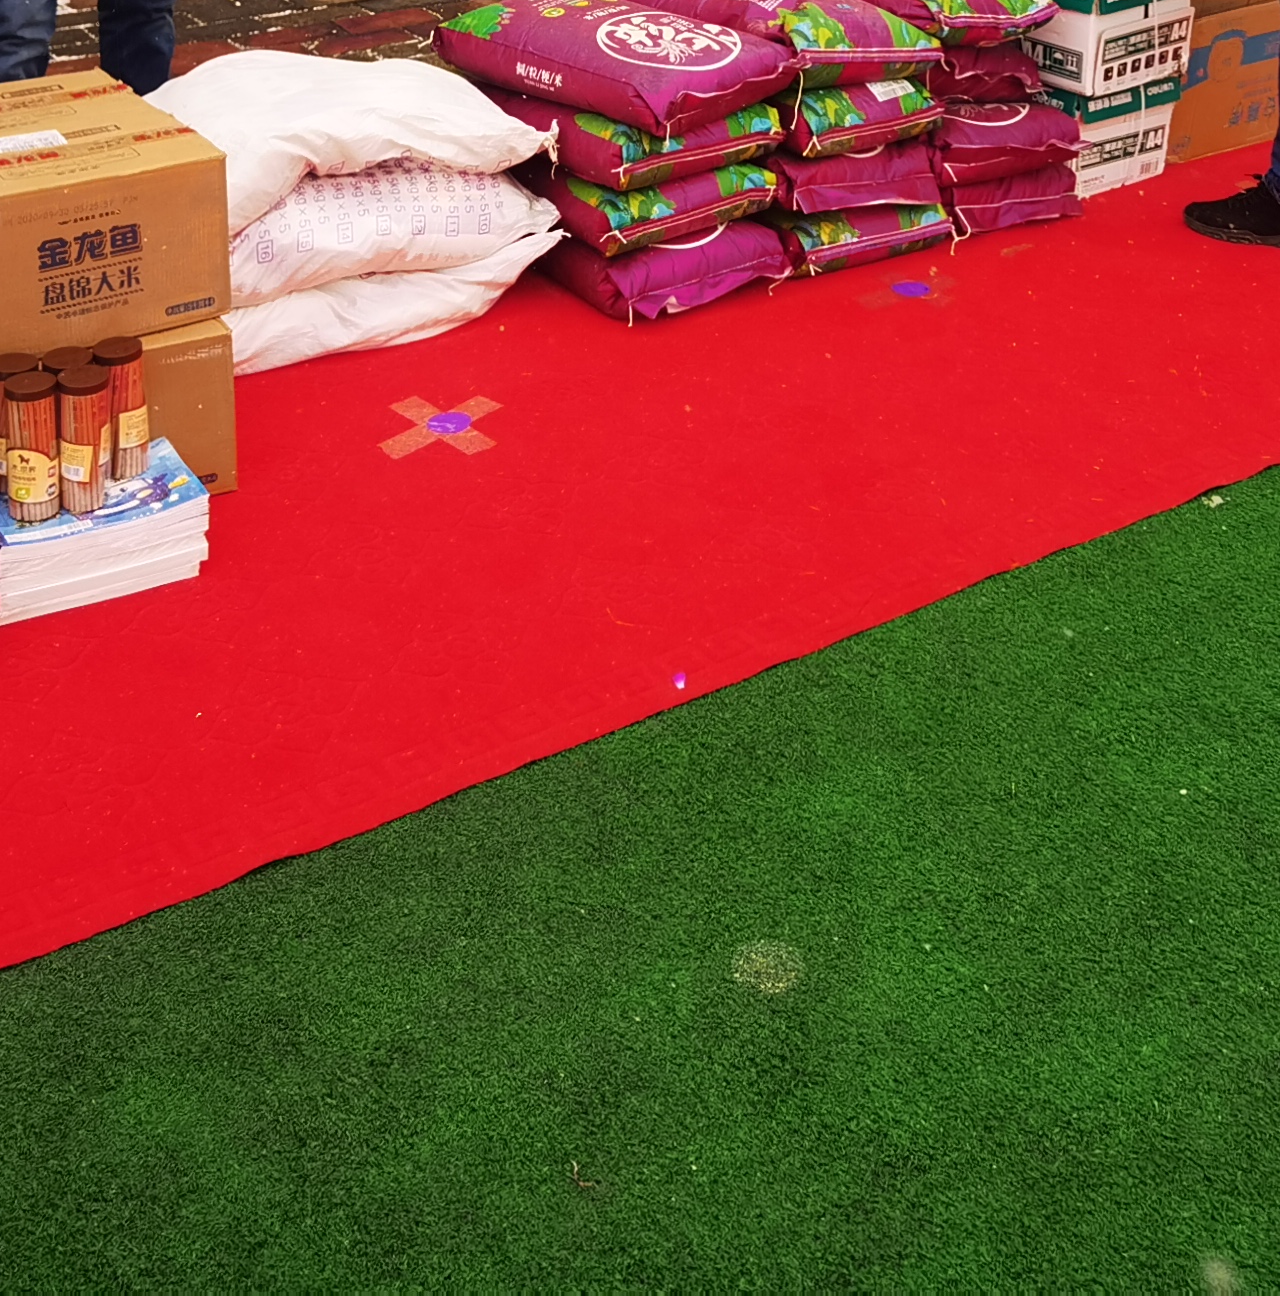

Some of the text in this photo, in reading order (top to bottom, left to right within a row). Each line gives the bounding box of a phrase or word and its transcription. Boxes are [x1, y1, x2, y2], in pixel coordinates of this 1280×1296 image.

[1171, 21, 1188, 42] A4
[1146, 129, 1163, 149] A4
[340, 225, 352, 242] 14
[379, 217, 391, 234] 13
[413, 216, 425, 235] 12
[447, 218, 458, 236] 11
[479, 215, 489, 233] 10
[36, 222, 144, 274] 金龙鱼
[299, 233, 312, 250] 15
[258, 243, 272, 262] 16
[41, 264, 143, 308] 盘锦大米
